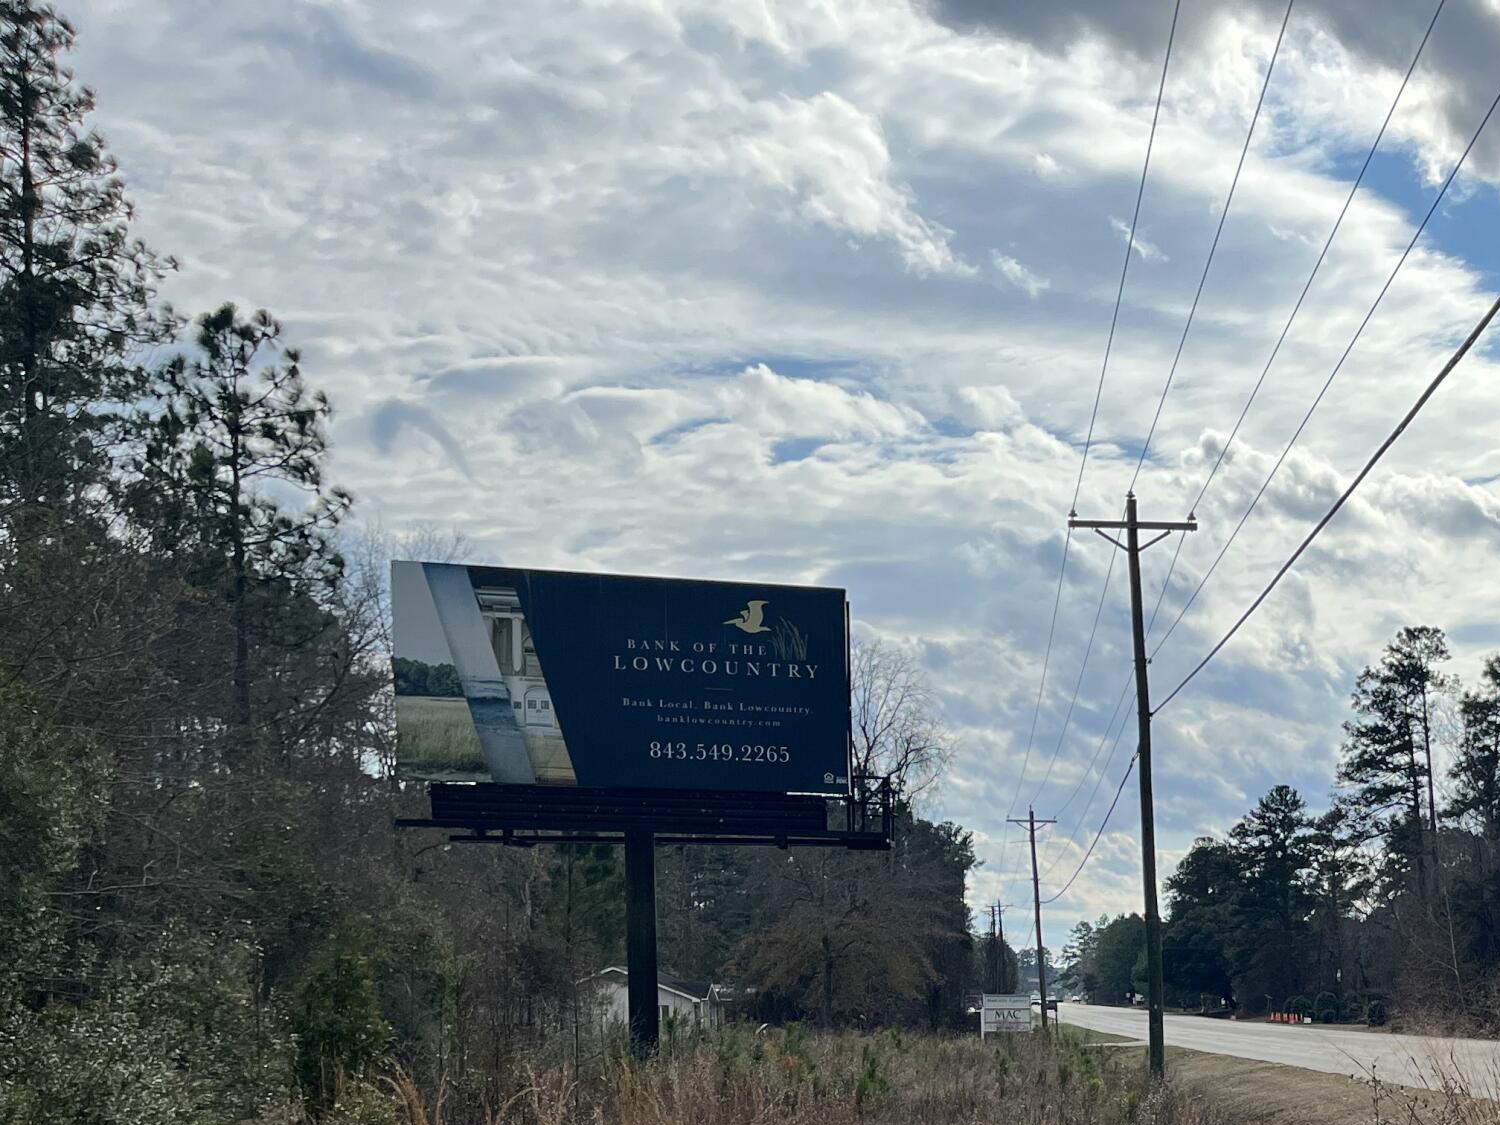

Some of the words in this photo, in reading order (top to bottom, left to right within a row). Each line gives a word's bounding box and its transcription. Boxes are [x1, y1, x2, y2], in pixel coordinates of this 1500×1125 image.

[627, 639, 681, 652] BANK
[693, 642, 717, 653] OF
[729, 644, 767, 655] THE
[614, 655, 819, 679] LOWCOUNTRY
[623, 697, 653, 707] Bank
[659, 699, 698, 710] Local.
[704, 701, 734, 711] Bank
[657, 714, 781, 727] banklowcountry.com
[649, 741, 790, 763] 843.549.2265
[995, 1010, 1021, 1019] MAC
